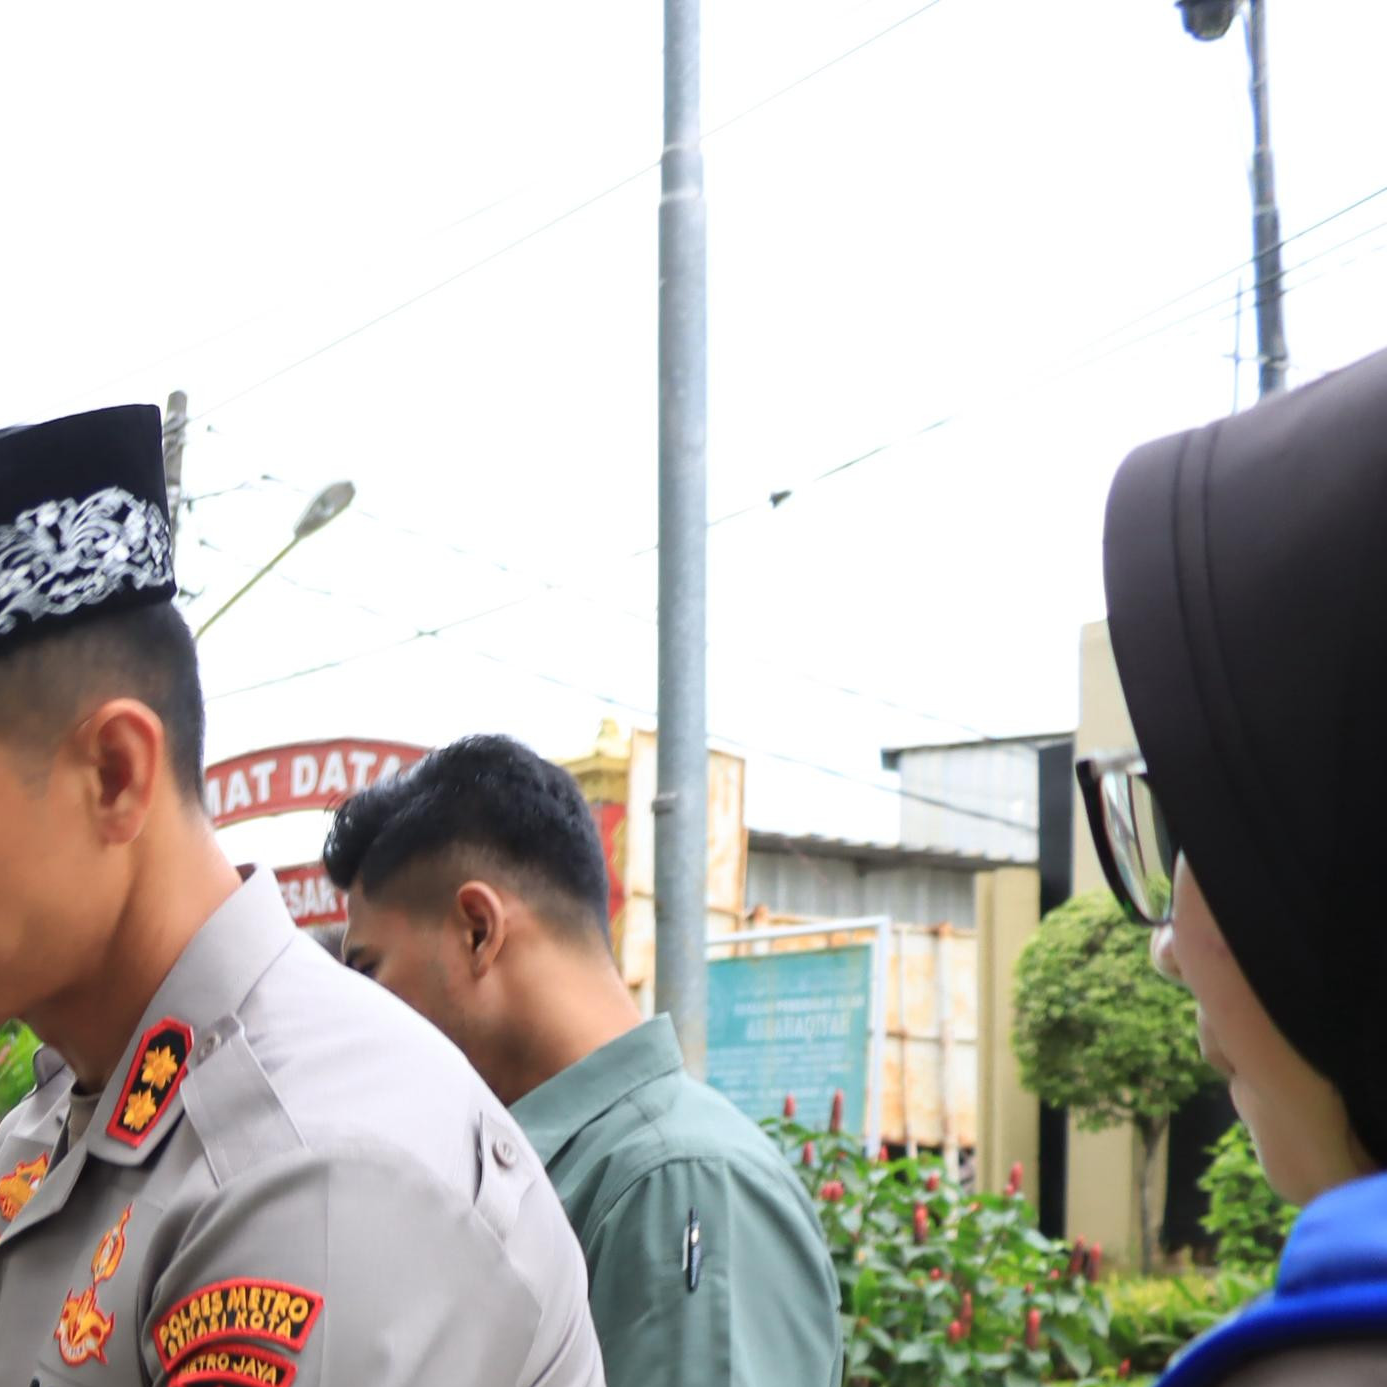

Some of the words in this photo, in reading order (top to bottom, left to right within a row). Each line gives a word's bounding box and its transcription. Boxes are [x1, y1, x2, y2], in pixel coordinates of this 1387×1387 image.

[159, 1290, 223, 1348] POLRES
[227, 1285, 309, 1323] METRO
[235, 1310, 291, 1340] KOTA
[233, 1354, 277, 1387] JAYA
